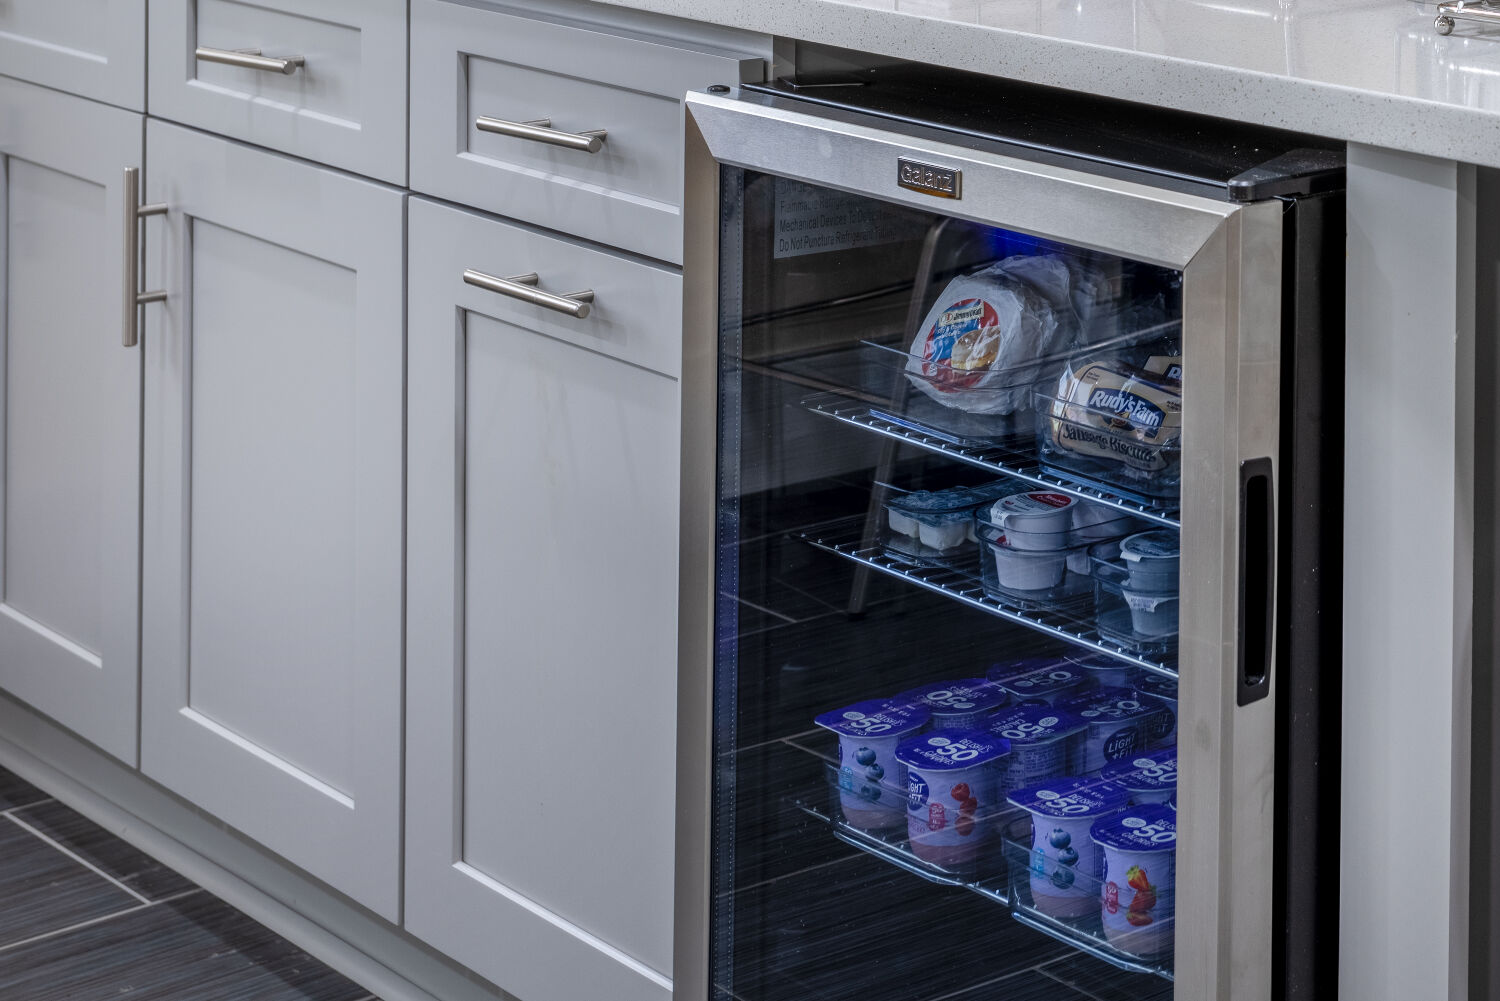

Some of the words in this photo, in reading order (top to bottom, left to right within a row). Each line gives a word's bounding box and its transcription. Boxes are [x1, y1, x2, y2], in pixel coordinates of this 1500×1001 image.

[900, 163, 953, 192] Galanz
[780, 214, 819, 232] Mechanical
[779, 239, 789, 252] Do
[790, 236, 803, 250] Not
[1090, 390, 1136, 413] Rudy's
[1132, 398, 1160, 426] Farm
[1063, 424, 1109, 449] Sausage
[850, 716, 892, 733] 50
[936, 741, 979, 761] 50
[1046, 797, 1090, 813] 50
[1132, 823, 1177, 843] 50
